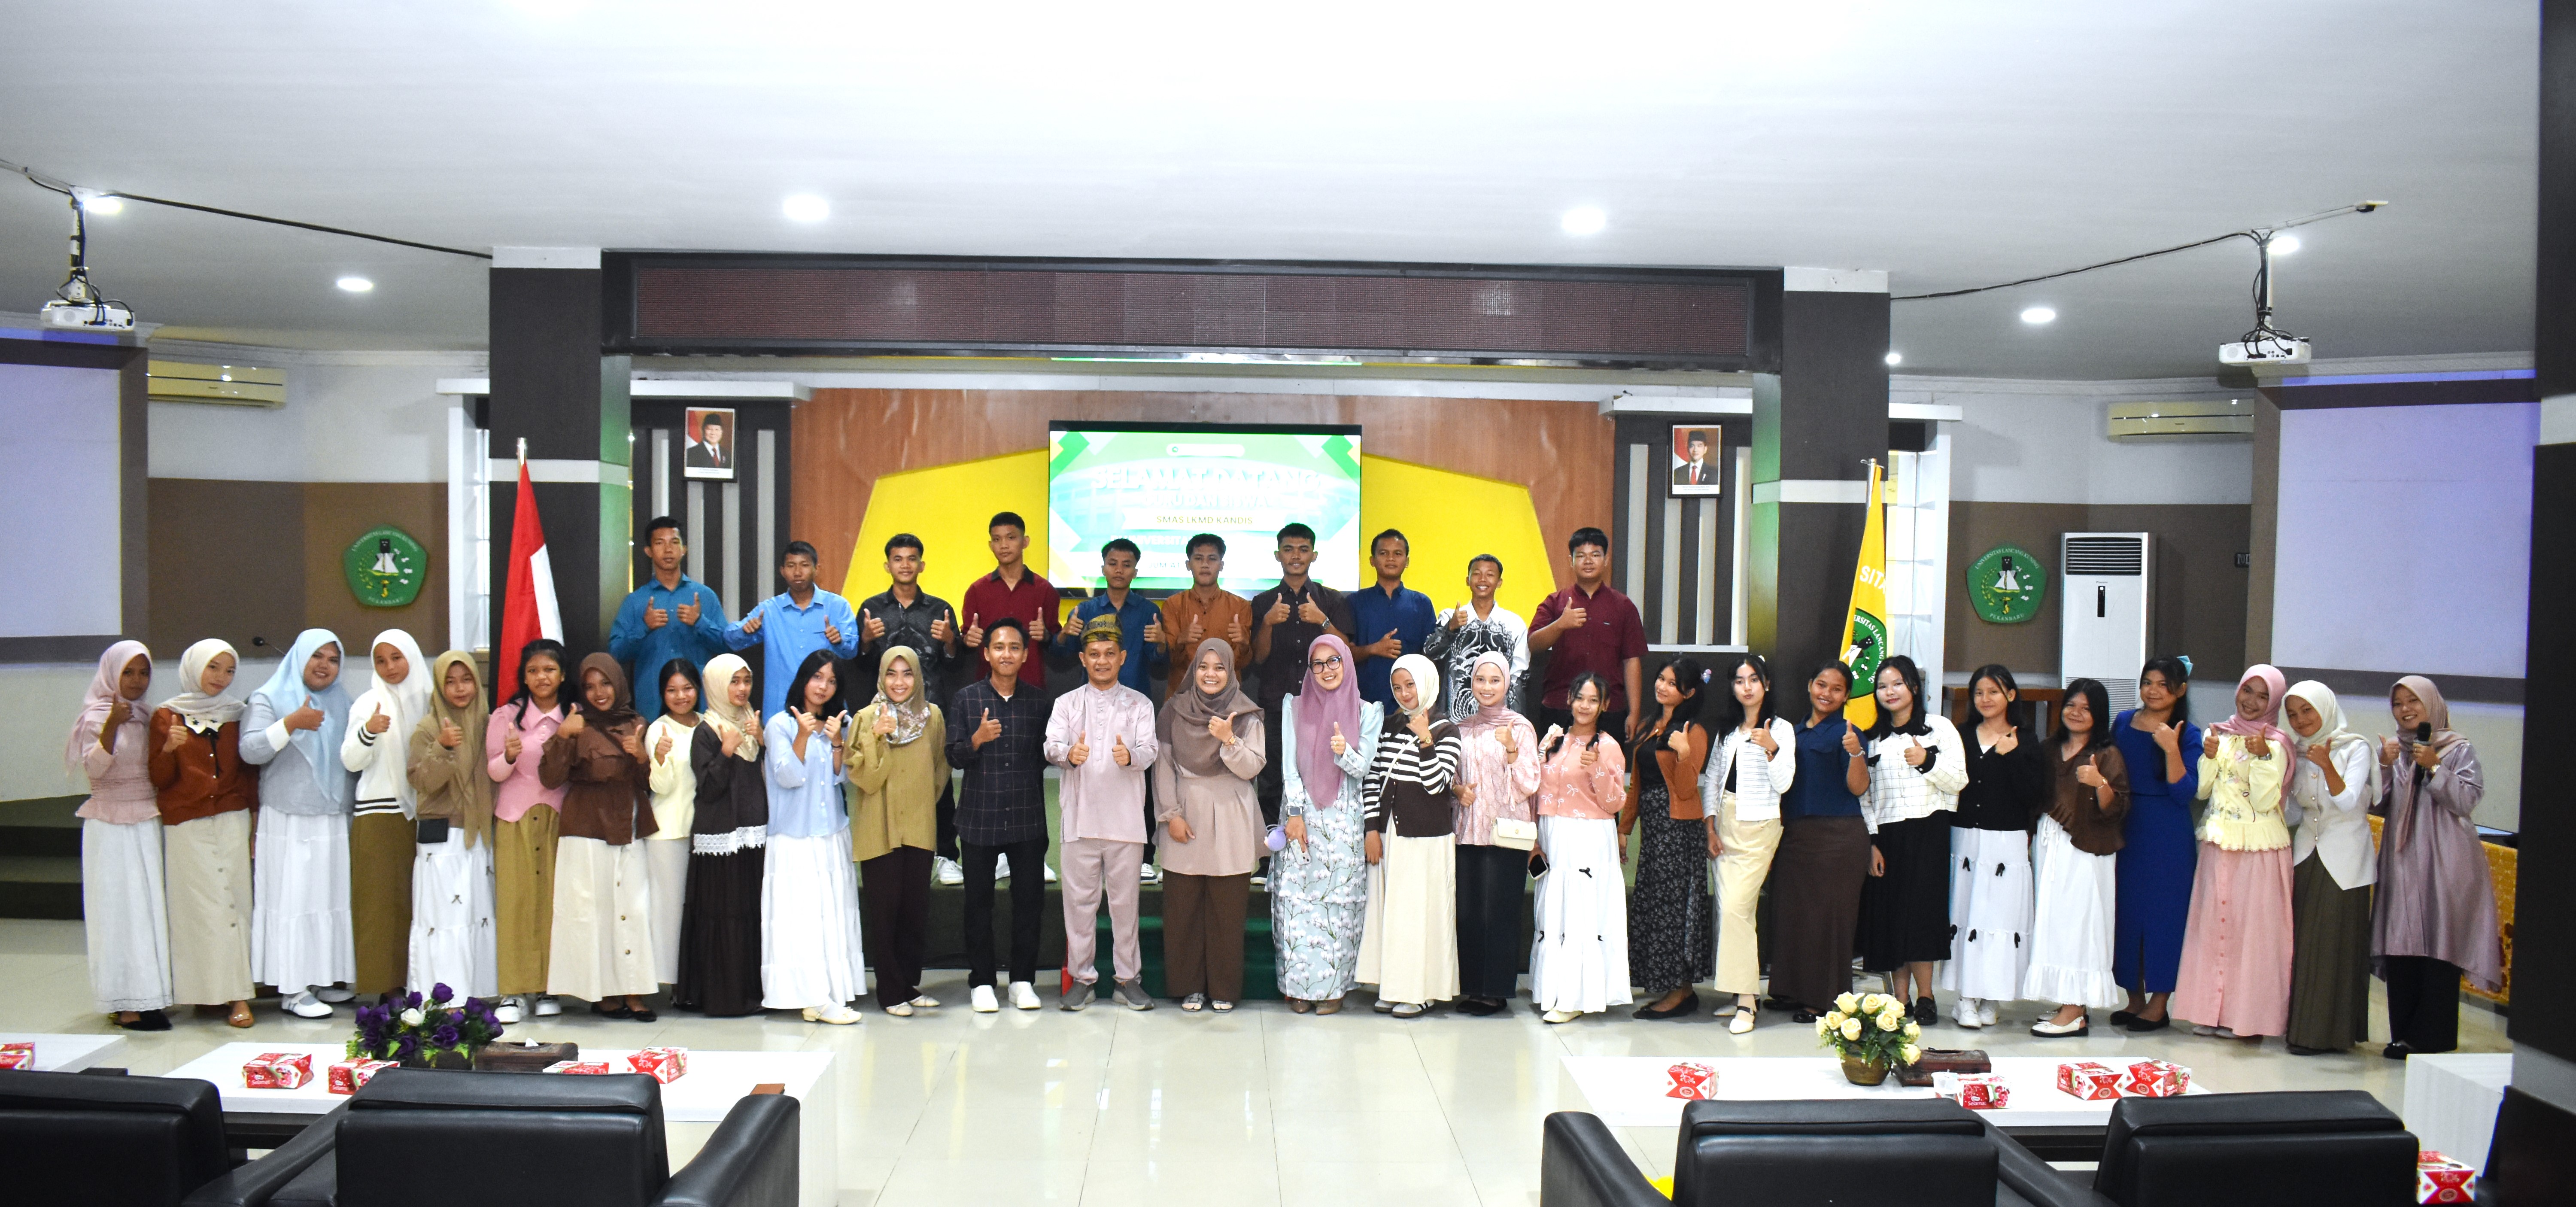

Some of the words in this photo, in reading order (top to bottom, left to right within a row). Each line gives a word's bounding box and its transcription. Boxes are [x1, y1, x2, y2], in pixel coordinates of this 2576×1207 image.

[1092, 468, 1209, 489] SELAMAT
[1212, 468, 1319, 492] DATANG
[1186, 494, 1218, 507] DAN
[1221, 494, 1271, 508] SISWA
[1872, 629, 1884, 660] LANCANG
